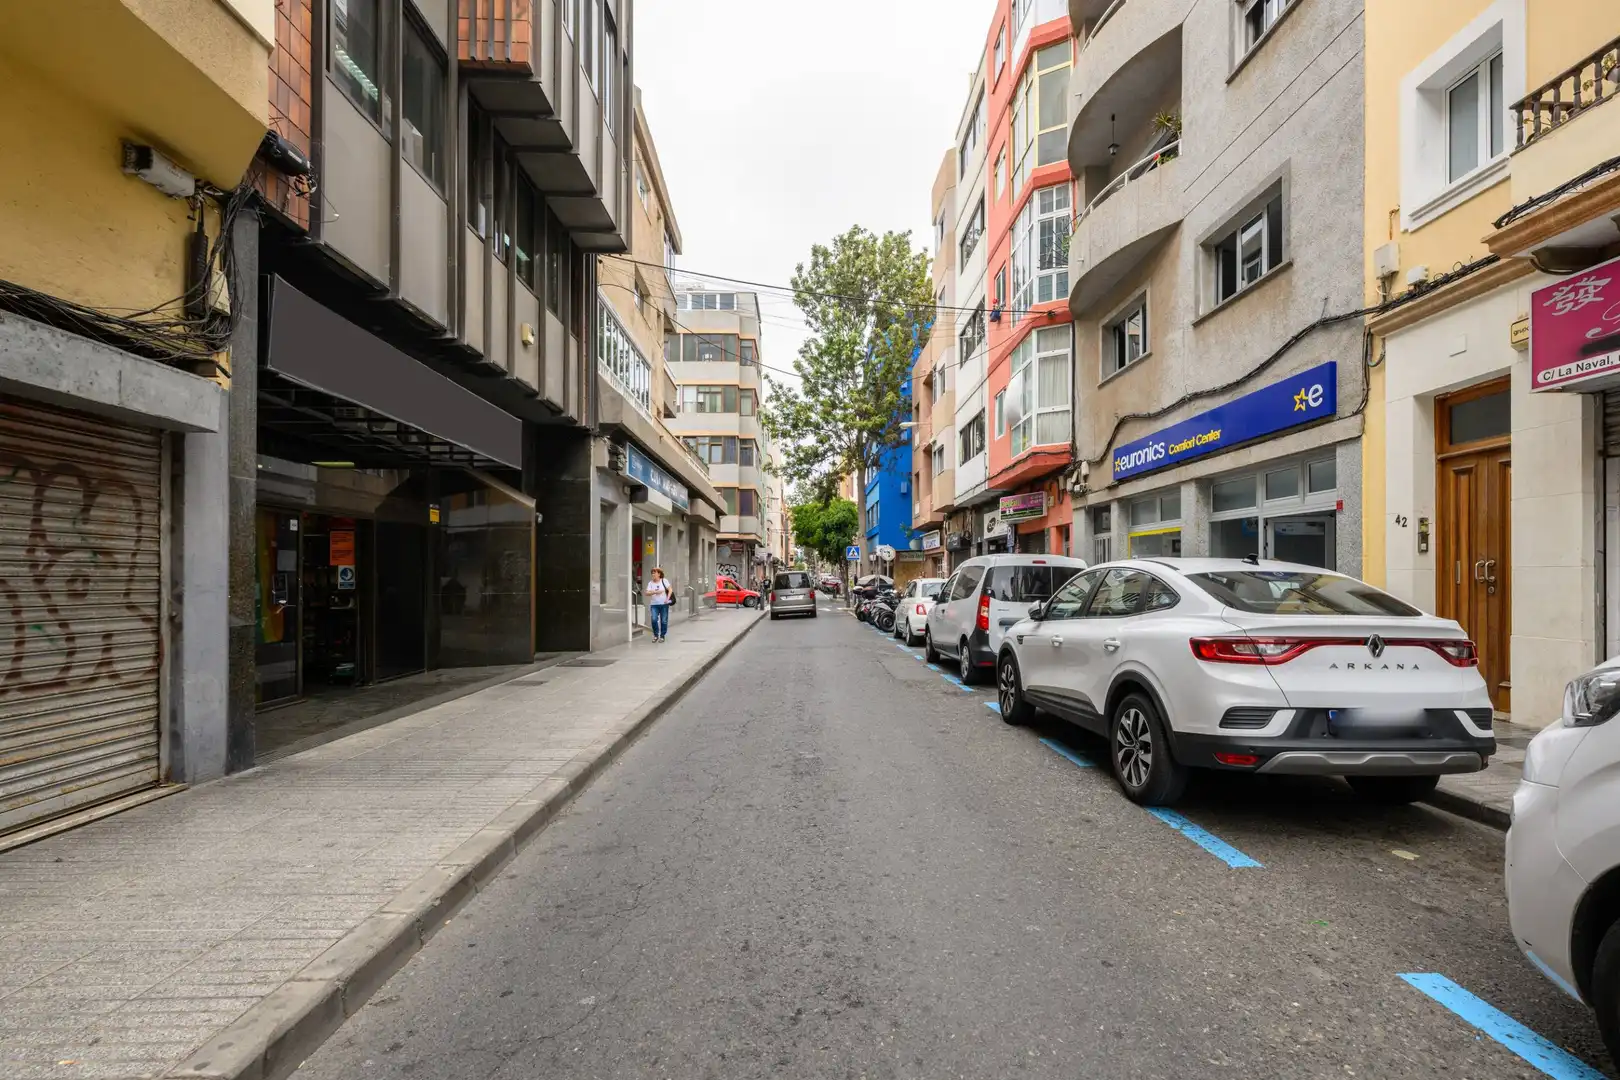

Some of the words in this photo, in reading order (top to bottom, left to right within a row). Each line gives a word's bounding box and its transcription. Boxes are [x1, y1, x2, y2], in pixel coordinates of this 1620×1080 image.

[1543, 369, 1556, 381] C/
[1558, 364, 1572, 377] La
[1576, 355, 1614, 372] Naval,
[1307, 383, 1324, 408] e
[1119, 441, 1165, 471] euronics
[1168, 436, 1195, 456] Comfort
[1195, 428, 1222, 446] Center
[1395, 514, 1408, 528] 42
[1329, 662, 1420, 671] ARKANA
